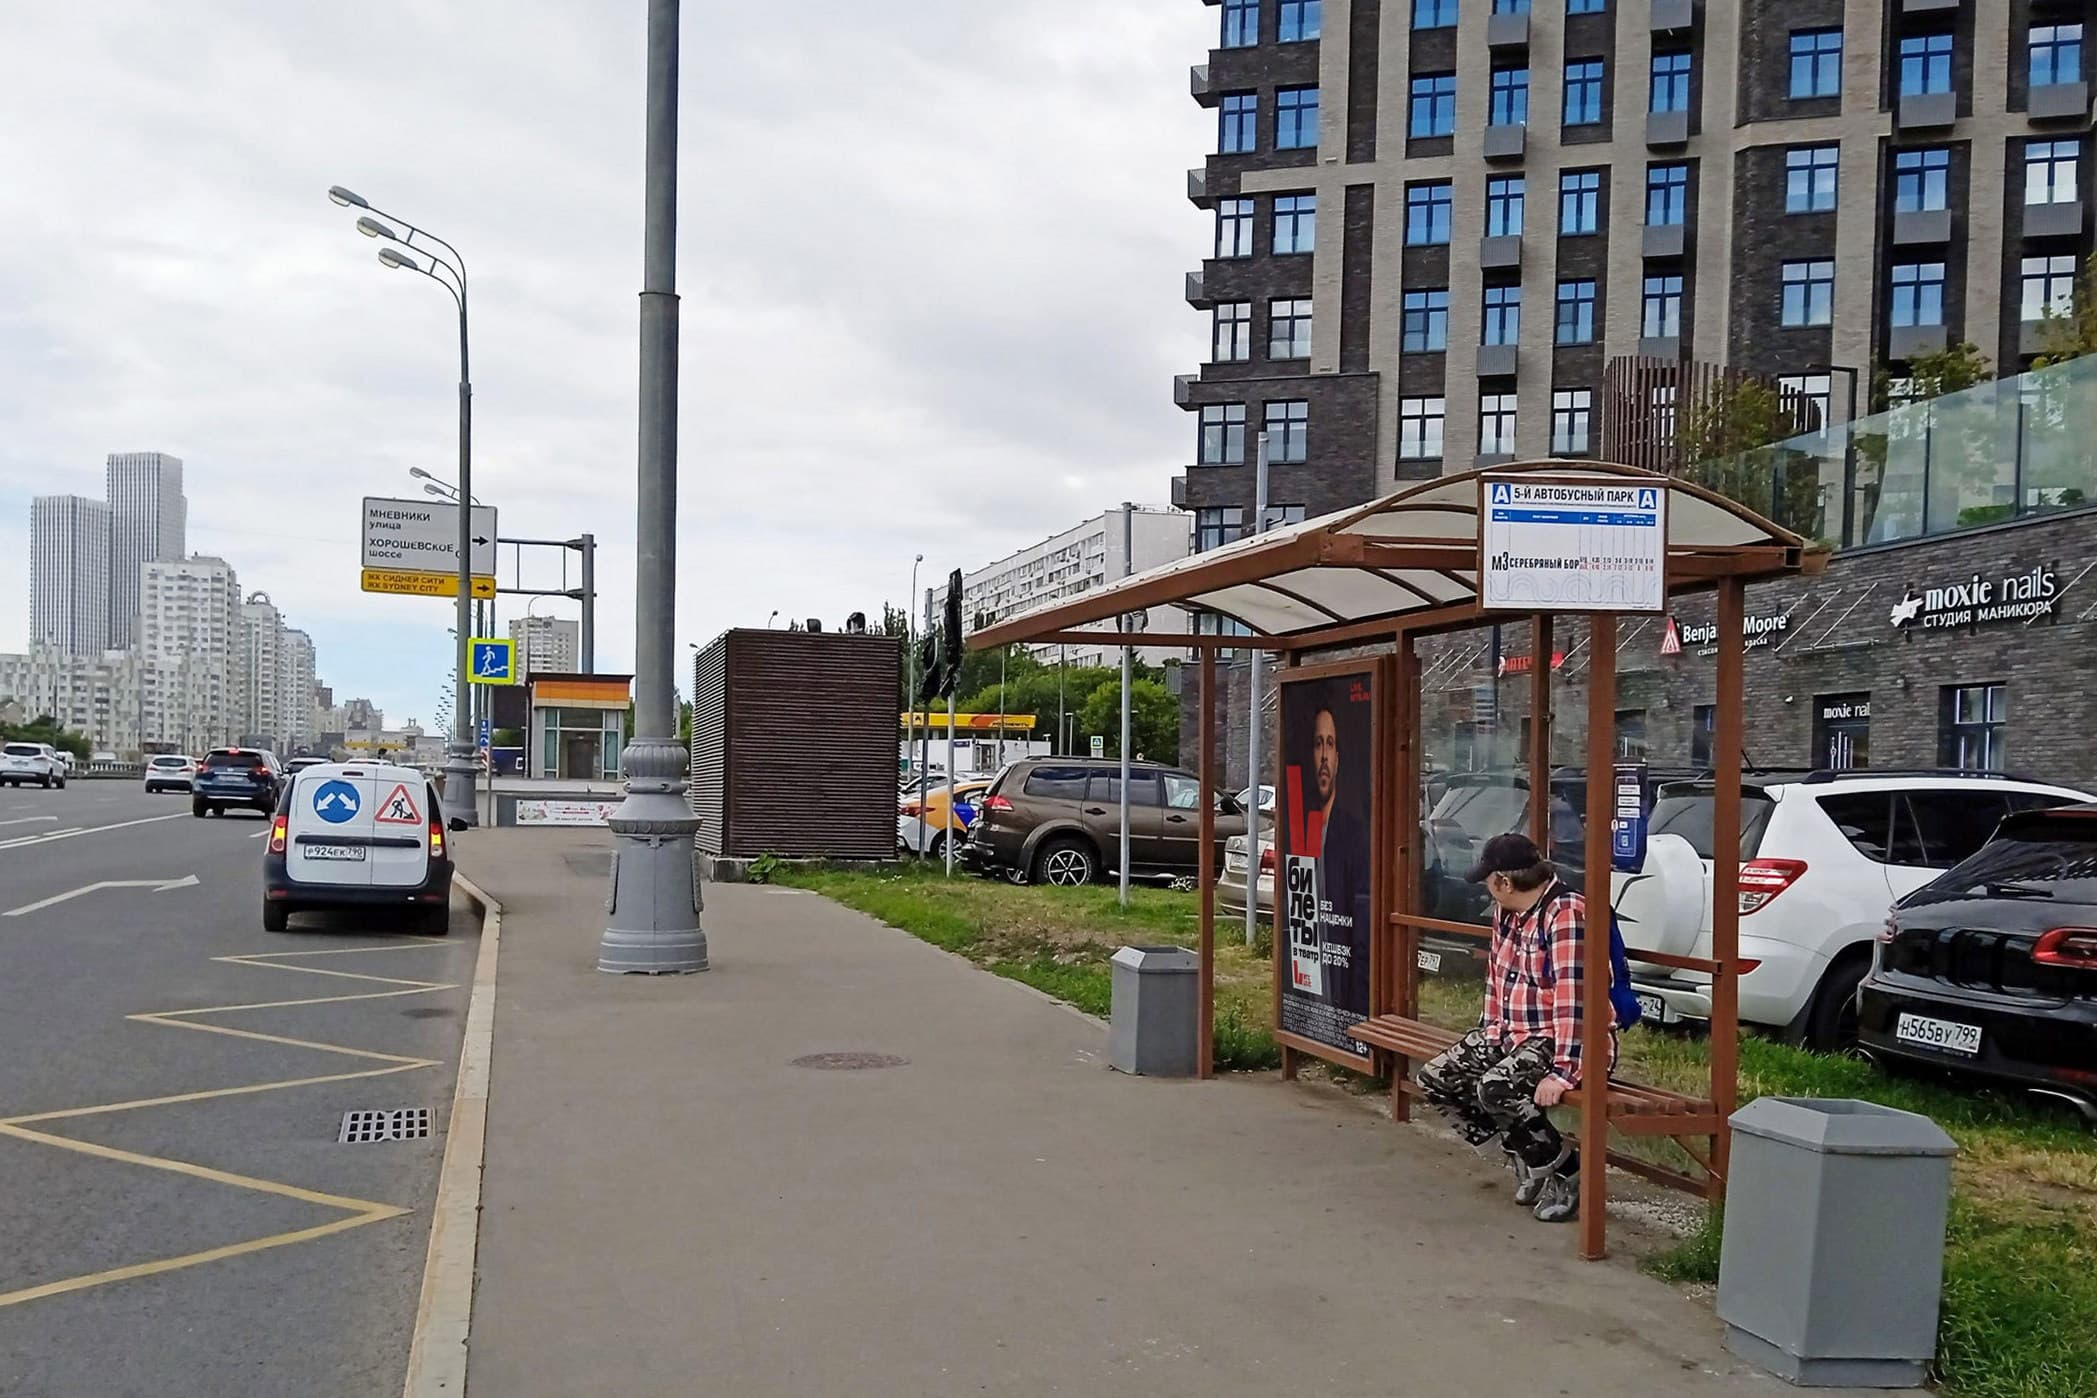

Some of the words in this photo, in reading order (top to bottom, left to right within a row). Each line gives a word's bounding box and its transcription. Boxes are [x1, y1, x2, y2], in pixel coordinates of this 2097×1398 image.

[1514, 486, 1531, 499] 5-Й
[1534, 487, 1604, 501] АВТОБУСНЫЙ
[1607, 491, 1634, 502] ПАРК
[369, 509, 431, 522] МНЕВНИКИ
[369, 521, 401, 530] улица
[369, 537, 454, 553] ХОРОШЕВСКОЕ
[369, 550, 402, 559] шоссе
[1509, 556, 1562, 570] СЕРЕБРЯНЫЙ
[1564, 558, 1580, 570] БОР
[382, 574, 419, 584] СИДНЕЙ
[421, 576, 445, 585] СИТИ
[382, 582, 417, 592] SYDNEY
[419, 584, 439, 592] CITY
[1924, 574, 1993, 611] moxie
[2002, 566, 2055, 601] nails
[1923, 610, 1971, 628] СТУДИЯ
[1977, 601, 2053, 621] МАНИКЮРА
[1682, 621, 1718, 645] Benja
[1742, 615, 1787, 635] Moore
[1823, 703, 1852, 719] moxie
[1287, 856, 1313, 893] би
[1290, 893, 1315, 921] ле
[1320, 900, 1333, 912] БЕЗ
[1320, 912, 1353, 928] НАЦЕНКИ
[1290, 918, 1319, 948] ты
[1298, 948, 1319, 963] театр
[1322, 941, 1351, 958] КЕШБЭК
[1321, 953, 1332, 966] ДО
[1333, 955, 1349, 969] 20%
[1901, 1018, 1952, 1043] Н565ВУ
[1955, 1025, 1977, 1043] 799
